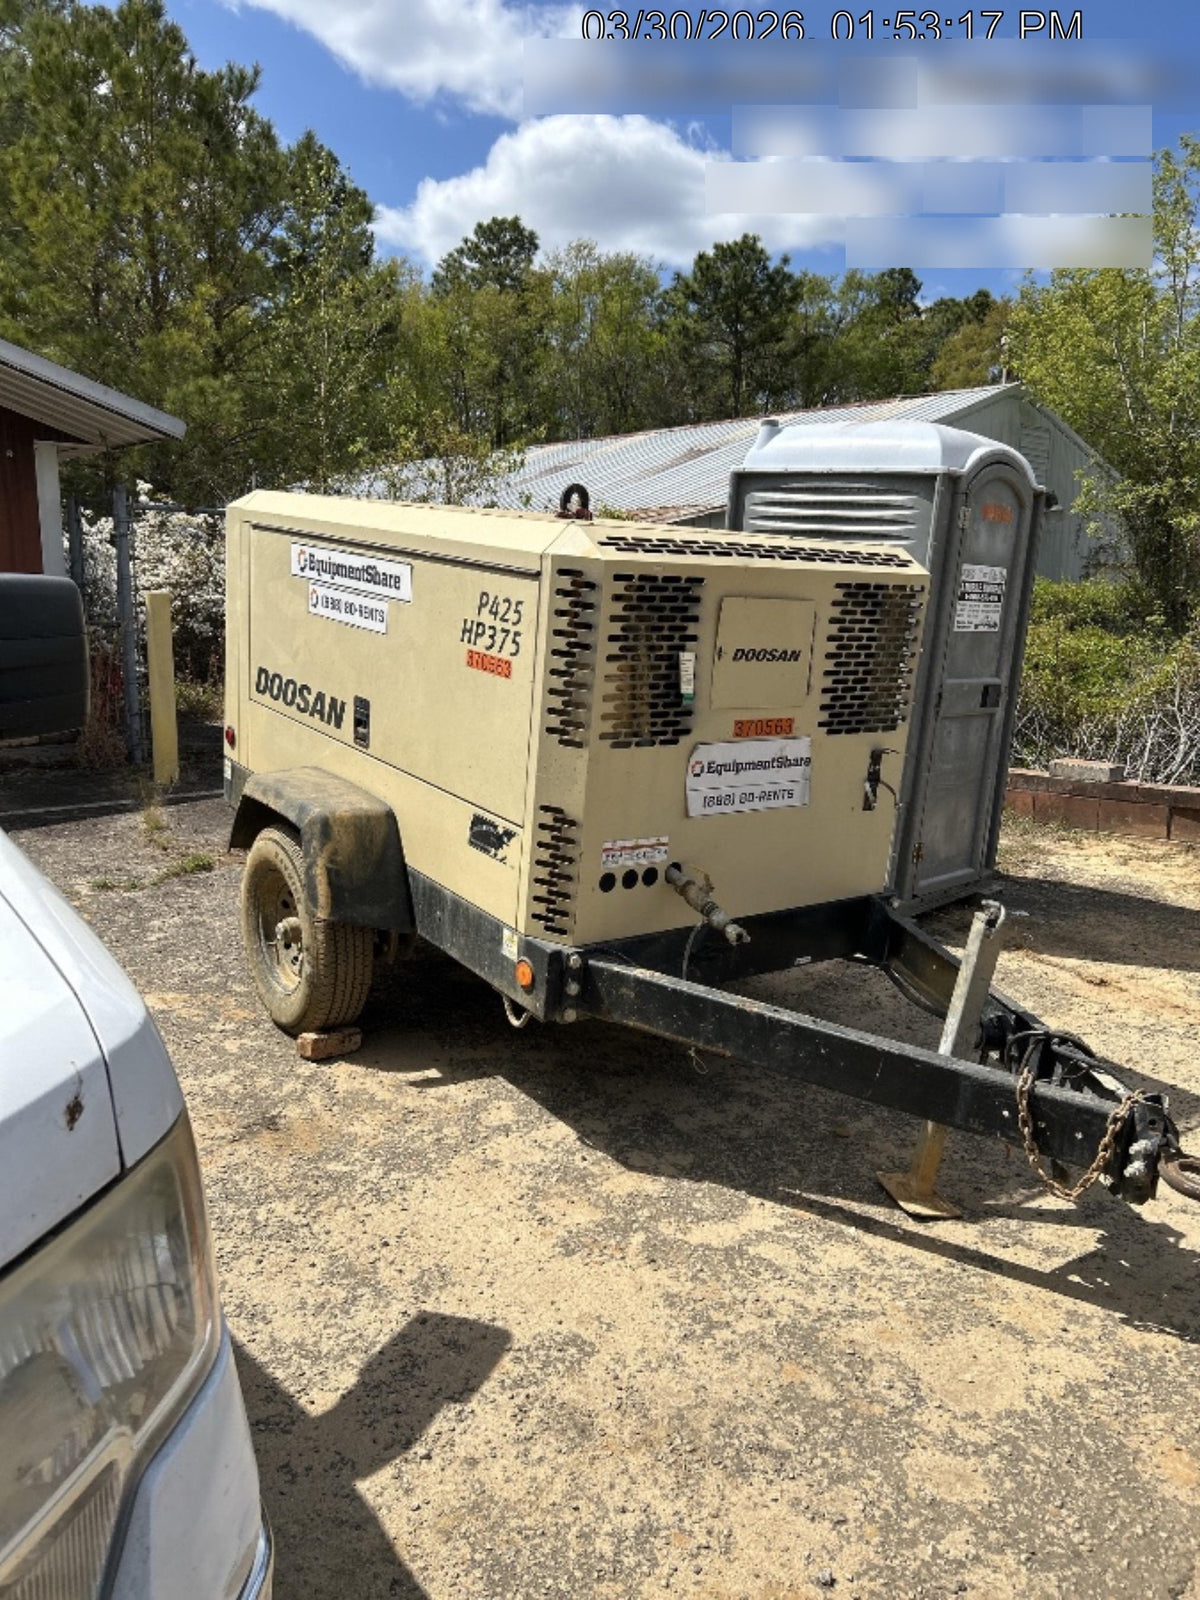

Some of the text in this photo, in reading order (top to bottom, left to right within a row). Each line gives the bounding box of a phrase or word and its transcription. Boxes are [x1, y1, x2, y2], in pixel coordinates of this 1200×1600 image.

[308, 552, 401, 591] EquipmentShare
[477, 591, 525, 627] P425
[460, 618, 522, 657] HP375
[466, 649, 512, 679] 370563
[732, 648, 802, 662] DOOSAN
[255, 666, 347, 730] DOOSAN
[734, 718, 794, 738] 370563
[705, 756, 812, 776] EquipmentShare
[703, 788, 795, 809] (888) 80-RENTS
